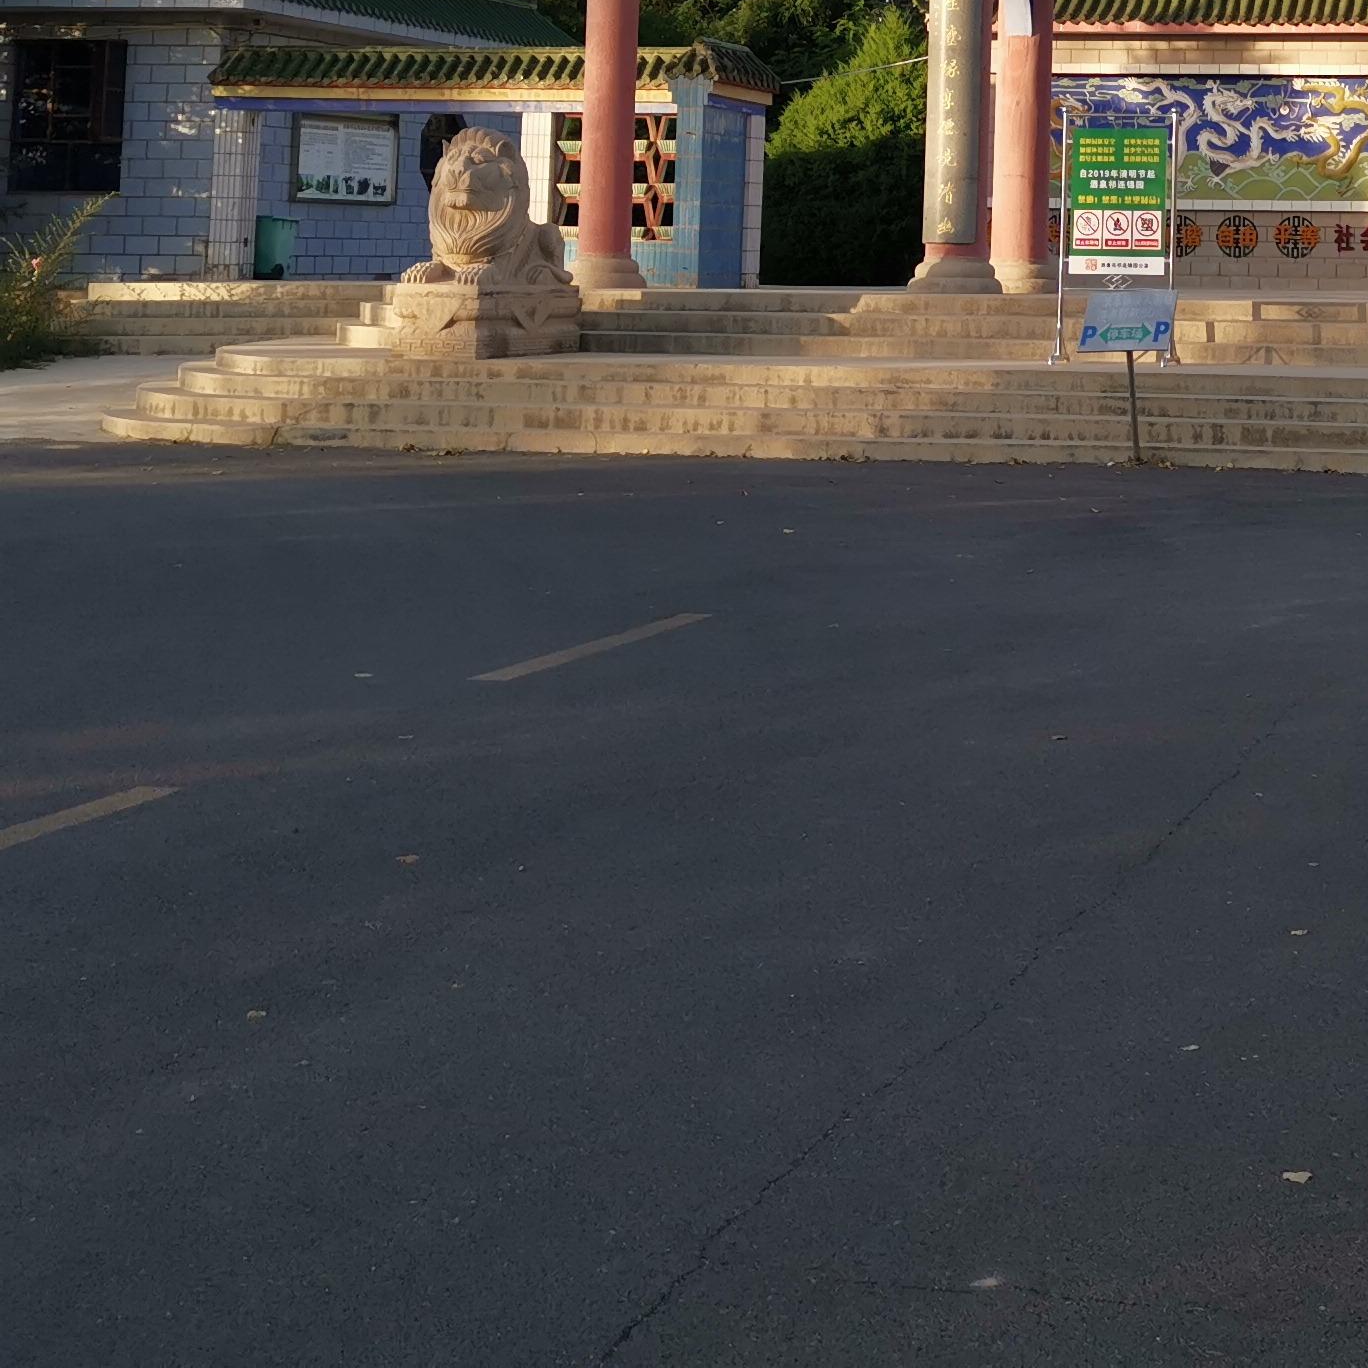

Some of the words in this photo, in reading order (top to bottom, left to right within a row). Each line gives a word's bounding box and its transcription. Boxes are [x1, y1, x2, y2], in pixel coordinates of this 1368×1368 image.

[1080, 169, 1156, 179] 自2019年清明节起
[1217, 225, 1259, 248] 自由
[1273, 224, 1321, 248] 平等
[1080, 325, 1098, 346] P
[1152, 321, 1170, 343] P
